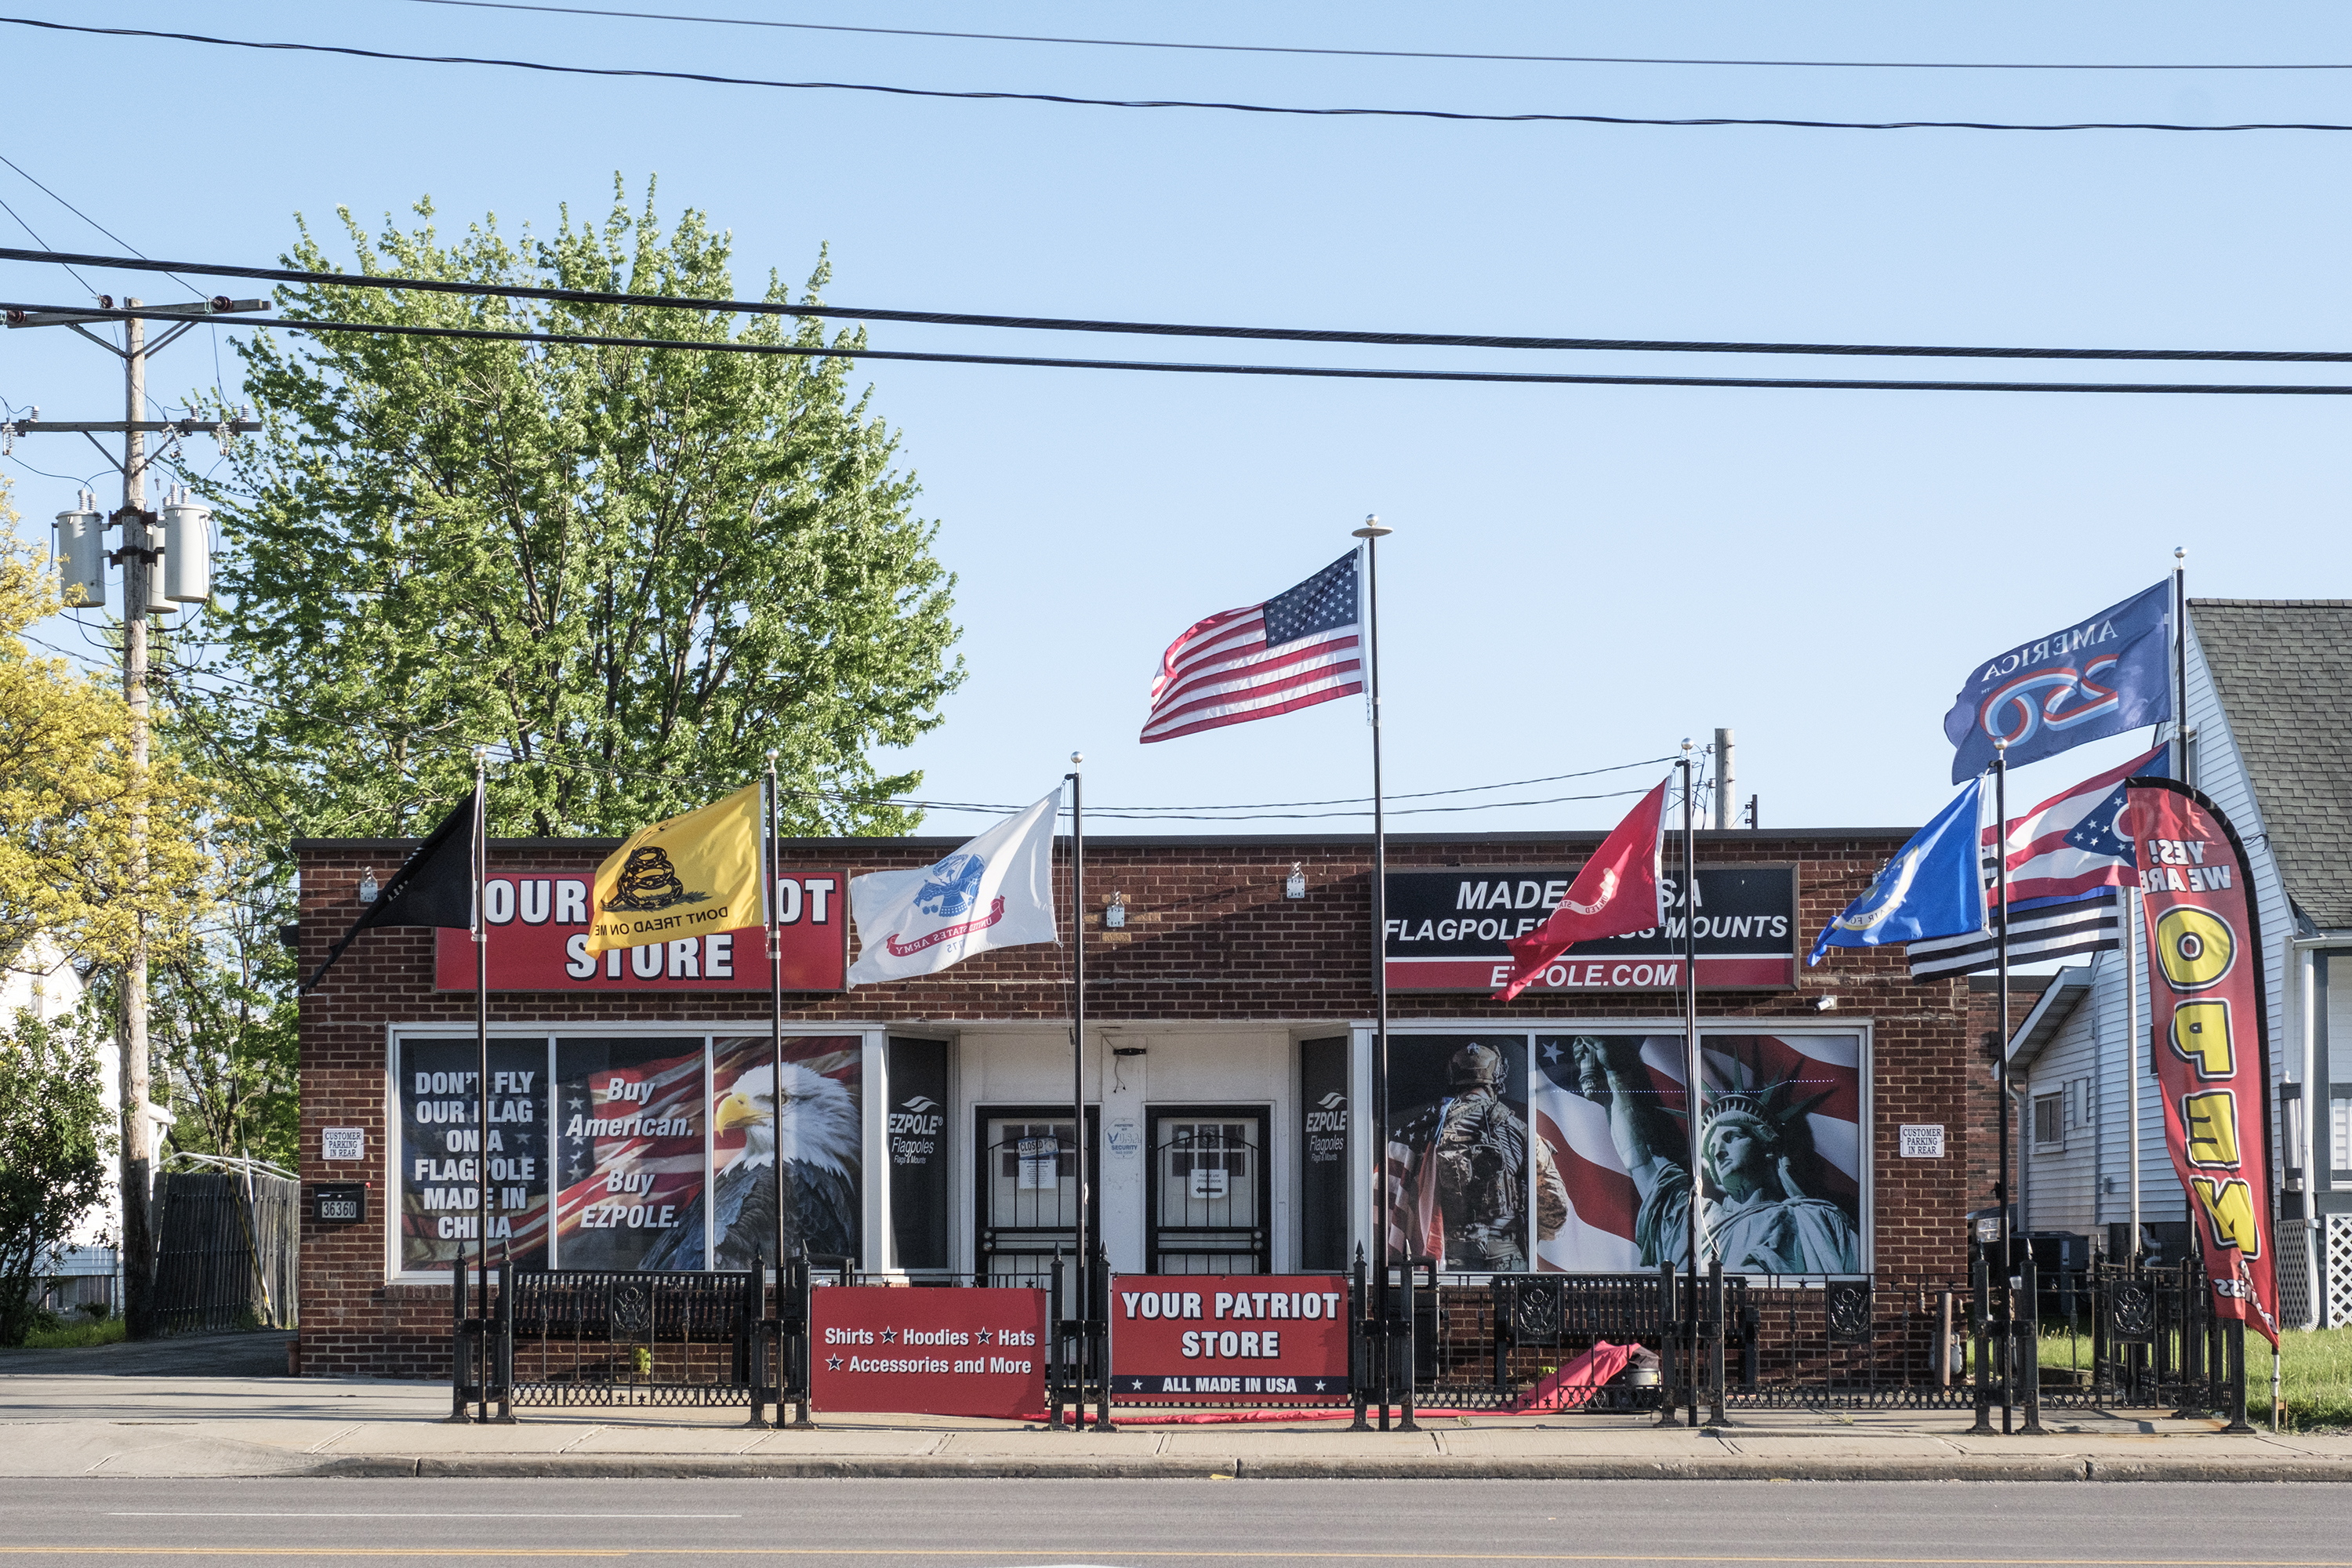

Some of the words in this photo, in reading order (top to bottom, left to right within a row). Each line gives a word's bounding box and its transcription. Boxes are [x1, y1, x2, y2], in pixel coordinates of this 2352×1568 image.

[475, 879, 589, 925] OUR
[1456, 880, 1567, 909] MADE
[1661, 879, 1702, 908] SA
[1385, 918, 1549, 941] FLAGPOLE
[1664, 916, 1788, 938] MOUNTS
[1490, 964, 1678, 987] EOLE.COM
[495, 1072, 535, 1094] FLY
[607, 1078, 655, 1105] Buy
[416, 1101, 465, 1123] OUR
[1305, 1110, 1348, 1132] EZPOLE
[565, 1114, 694, 1137] American.
[446, 1130, 480, 1152] ON
[486, 1130, 504, 1152] A
[891, 1137, 935, 1157] Flagpoles
[1020, 1140, 1044, 1152] CLOSD
[1309, 1134, 1344, 1154] Flagpoles
[910, 1156, 926, 1164] Mounts
[606, 1169, 655, 1197] Buy
[324, 1202, 355, 1216] 36360
[502, 1187, 526, 1209] IN
[580, 1205, 680, 1228] EZPOLE.
[1121, 1292, 1202, 1319] YOUR
[1215, 1292, 1339, 1319] PATRIOT
[825, 1327, 874, 1345] Shirts
[903, 1329, 969, 1346] Hoodies
[998, 1330, 1036, 1346] Hats
[1181, 1330, 1279, 1358] STORE
[849, 1356, 949, 1373] Accessories
[954, 1356, 985, 1373] and
[990, 1357, 1032, 1373] More
[1162, 1377, 1191, 1392] ALL
[1196, 1377, 1240, 1392] MADE
[1245, 1377, 1261, 1392] IN
[1266, 1377, 1298, 1392] USA
